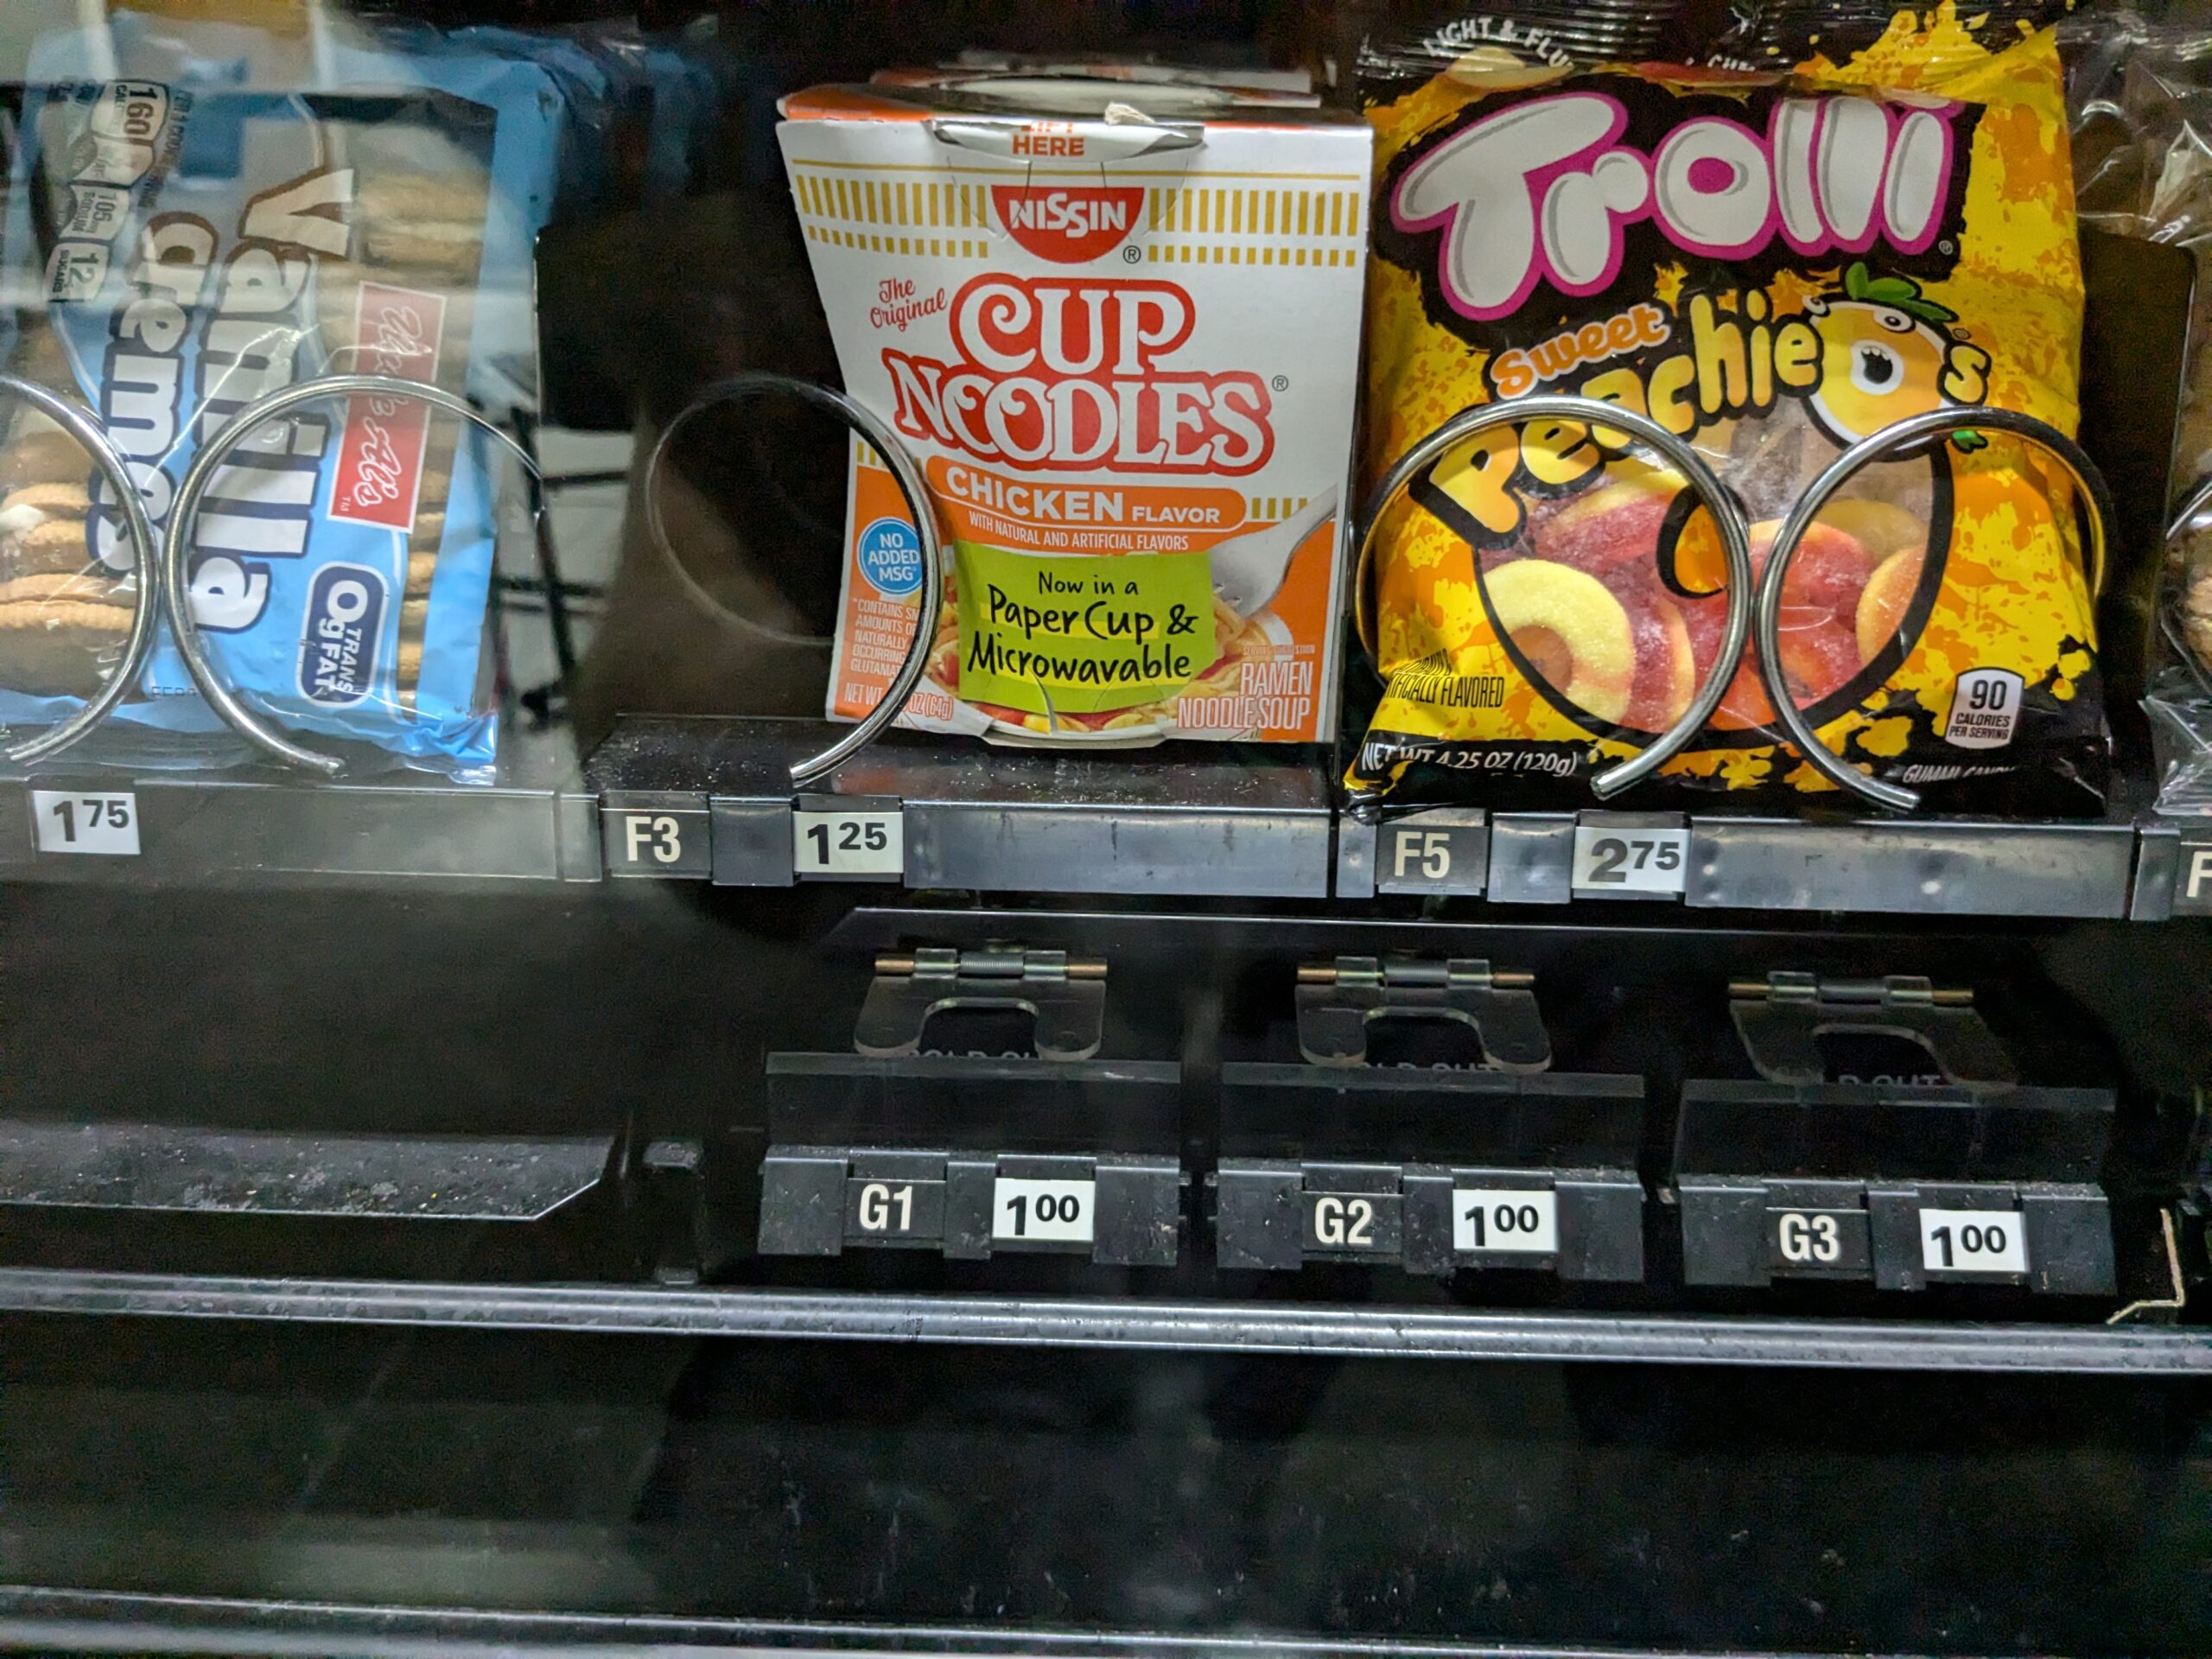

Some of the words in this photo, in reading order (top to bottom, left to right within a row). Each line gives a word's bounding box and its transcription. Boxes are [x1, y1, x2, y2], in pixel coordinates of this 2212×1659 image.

[1423, 17, 1491, 57] LIGHT
[1500, 19, 1518, 41] &
[1524, 28, 1574, 68] FLU
[124, 86, 159, 136] 160
[1012, 135, 1084, 156] HERE
[73, 192, 94, 232] SODIUM
[1009, 192, 1127, 238] NISSIN
[1391, 92, 1961, 320] Trolli
[870, 288, 947, 332] Original
[879, 278, 916, 302] The
[956, 278, 1189, 378] CUP
[369, 307, 423, 417] Unce
[1491, 302, 1670, 399] Sweet
[189, 168, 354, 631] Vanilla
[887, 353, 1270, 472] NOODLES
[946, 467, 1123, 522] CHICKEN
[1133, 506, 1220, 524] FLAVOR
[880, 533, 904, 548] NO
[969, 510, 993, 532] WITH
[995, 520, 1041, 545] NATURAL
[1044, 531, 1068, 547] AND
[1071, 533, 1134, 550] ARTIFICIAL
[1137, 535, 1189, 550] FLAVORS
[868, 550, 920, 566] ADDED
[1039, 571, 1084, 594] Now
[1094, 574, 1115, 594] in
[1124, 581, 1139, 595] a
[855, 614, 904, 633] AMOUNTS
[988, 583, 1080, 640] Paper
[1085, 601, 1154, 645] Cup
[1166, 604, 1198, 635] &
[334, 626, 362, 693] TRANS
[853, 644, 906, 664] OCCURRING
[855, 630, 907, 650] NATURALLY
[968, 630, 1192, 685] Microwavable
[315, 645, 340, 694] FAT
[850, 659, 902, 678] GLUTAMAT
[1240, 661, 1314, 696] RAMEN
[844, 683, 864, 704] NET
[925, 693, 955, 720] (64g)
[1178, 697, 1255, 728] NOODLE
[1257, 696, 1311, 730] SOUP
[1440, 676, 1505, 708] FLAVORED
[1969, 679, 2007, 710] 90
[1949, 726, 1967, 738] PER
[1969, 728, 2010, 740] SERVING
[1955, 713, 2011, 728] CALORIES
[1362, 742, 1396, 771] NET
[1436, 751, 1480, 770] 4.25
[1484, 752, 1514, 768] OZ
[1514, 751, 1578, 777] (120g)
[626, 816, 681, 863] F3
[1394, 830, 1451, 879] F5
[2186, 851, 2212, 897] F
[859, 1184, 912, 1230] G1
[1314, 1197, 1373, 1245] G2
[1779, 1213, 1840, 1262] G3
